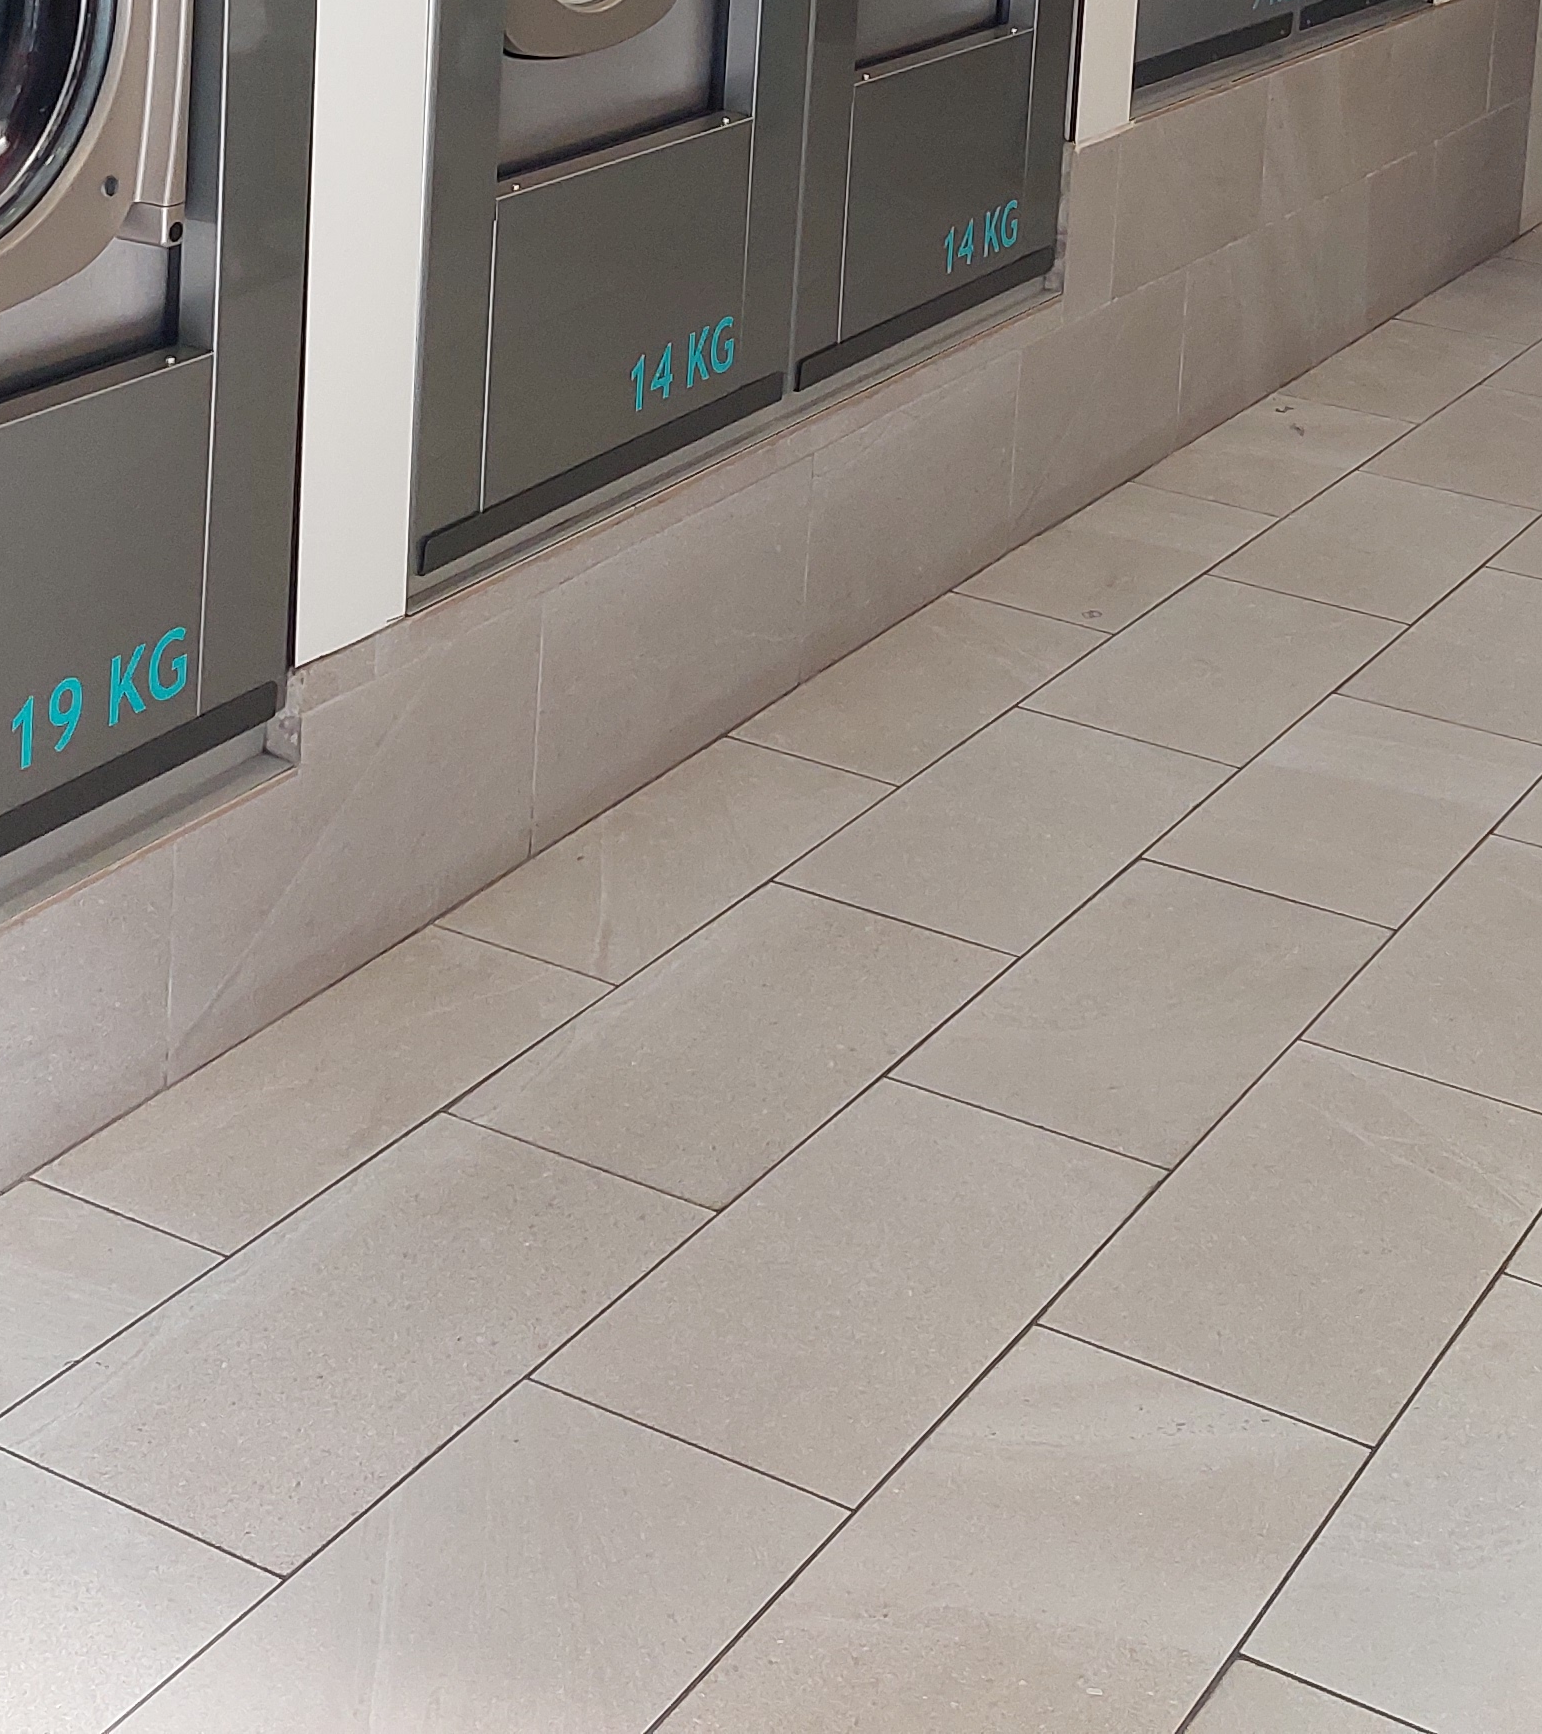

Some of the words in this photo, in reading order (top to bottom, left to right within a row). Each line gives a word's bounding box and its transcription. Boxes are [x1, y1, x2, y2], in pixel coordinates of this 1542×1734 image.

[944, 218, 974, 274] 14
[983, 200, 1018, 257] KG
[630, 342, 674, 412] 14
[686, 317, 735, 388] KG
[11, 674, 81, 770] 19
[107, 627, 187, 730] KG
